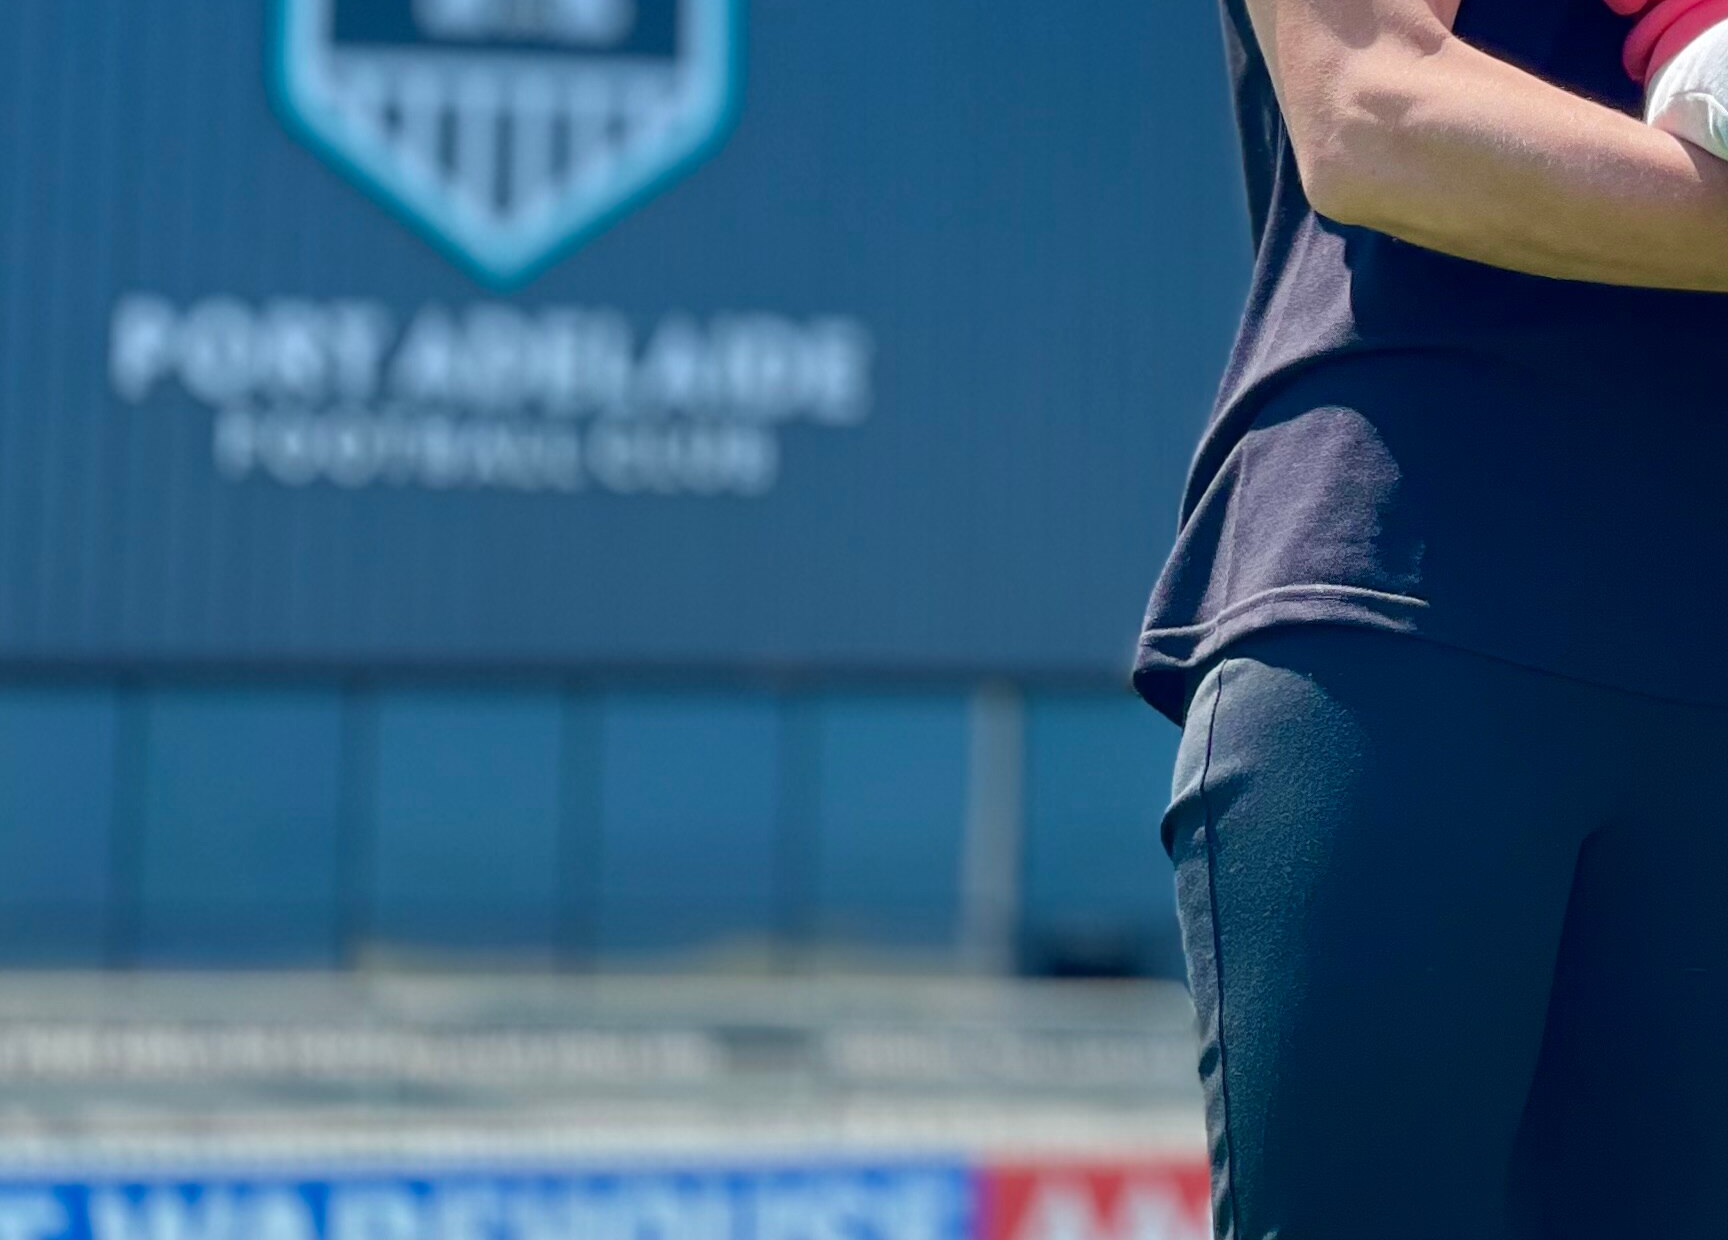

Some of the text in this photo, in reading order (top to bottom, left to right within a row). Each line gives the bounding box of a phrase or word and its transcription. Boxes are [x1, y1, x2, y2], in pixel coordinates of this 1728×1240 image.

[112, 296, 868, 422] PORT ADELAIDE
[220, 408, 775, 493] FOOTBALL CLUB
